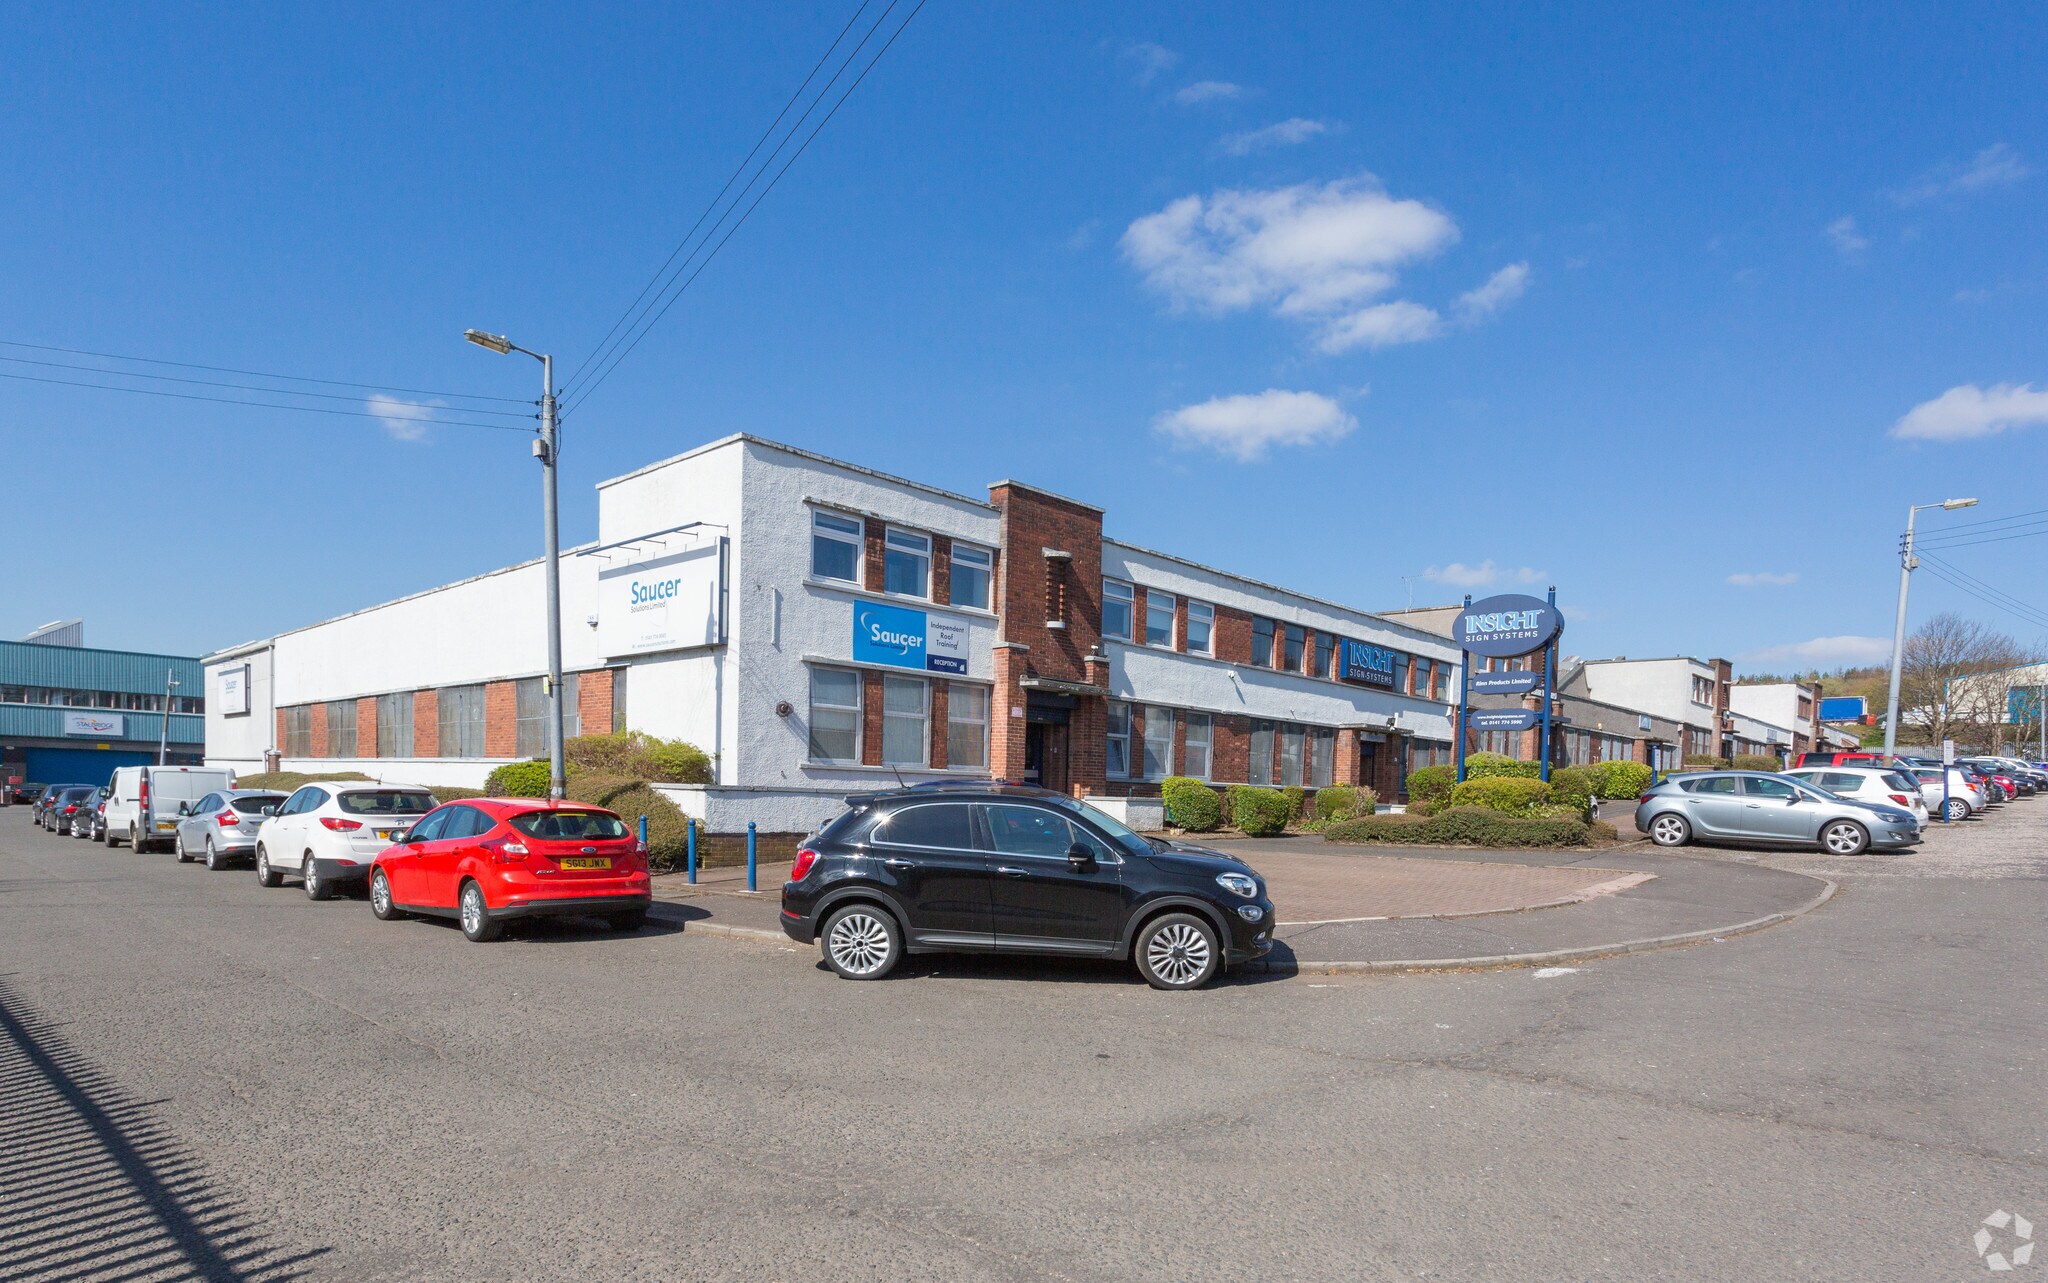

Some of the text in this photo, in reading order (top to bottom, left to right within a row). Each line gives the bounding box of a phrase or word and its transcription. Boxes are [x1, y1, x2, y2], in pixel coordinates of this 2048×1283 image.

[631, 578, 681, 605] Saucer
[630, 601, 666, 613] Solutions Limited
[930, 621, 965, 633] Independent
[1464, 609, 1541, 633] INSIGHT
[871, 623, 923, 647] Saucer
[940, 632, 954, 641] Roof
[1493, 631, 1538, 640] SYSTEMS
[936, 639, 958, 650] Training
[934, 658, 958, 667] RECEPTION
[1350, 641, 1396, 674] INSIGHT
[1350, 668, 1393, 684] SIGN SYSTEMS
[566, 859, 606, 868] SG13 JWX
